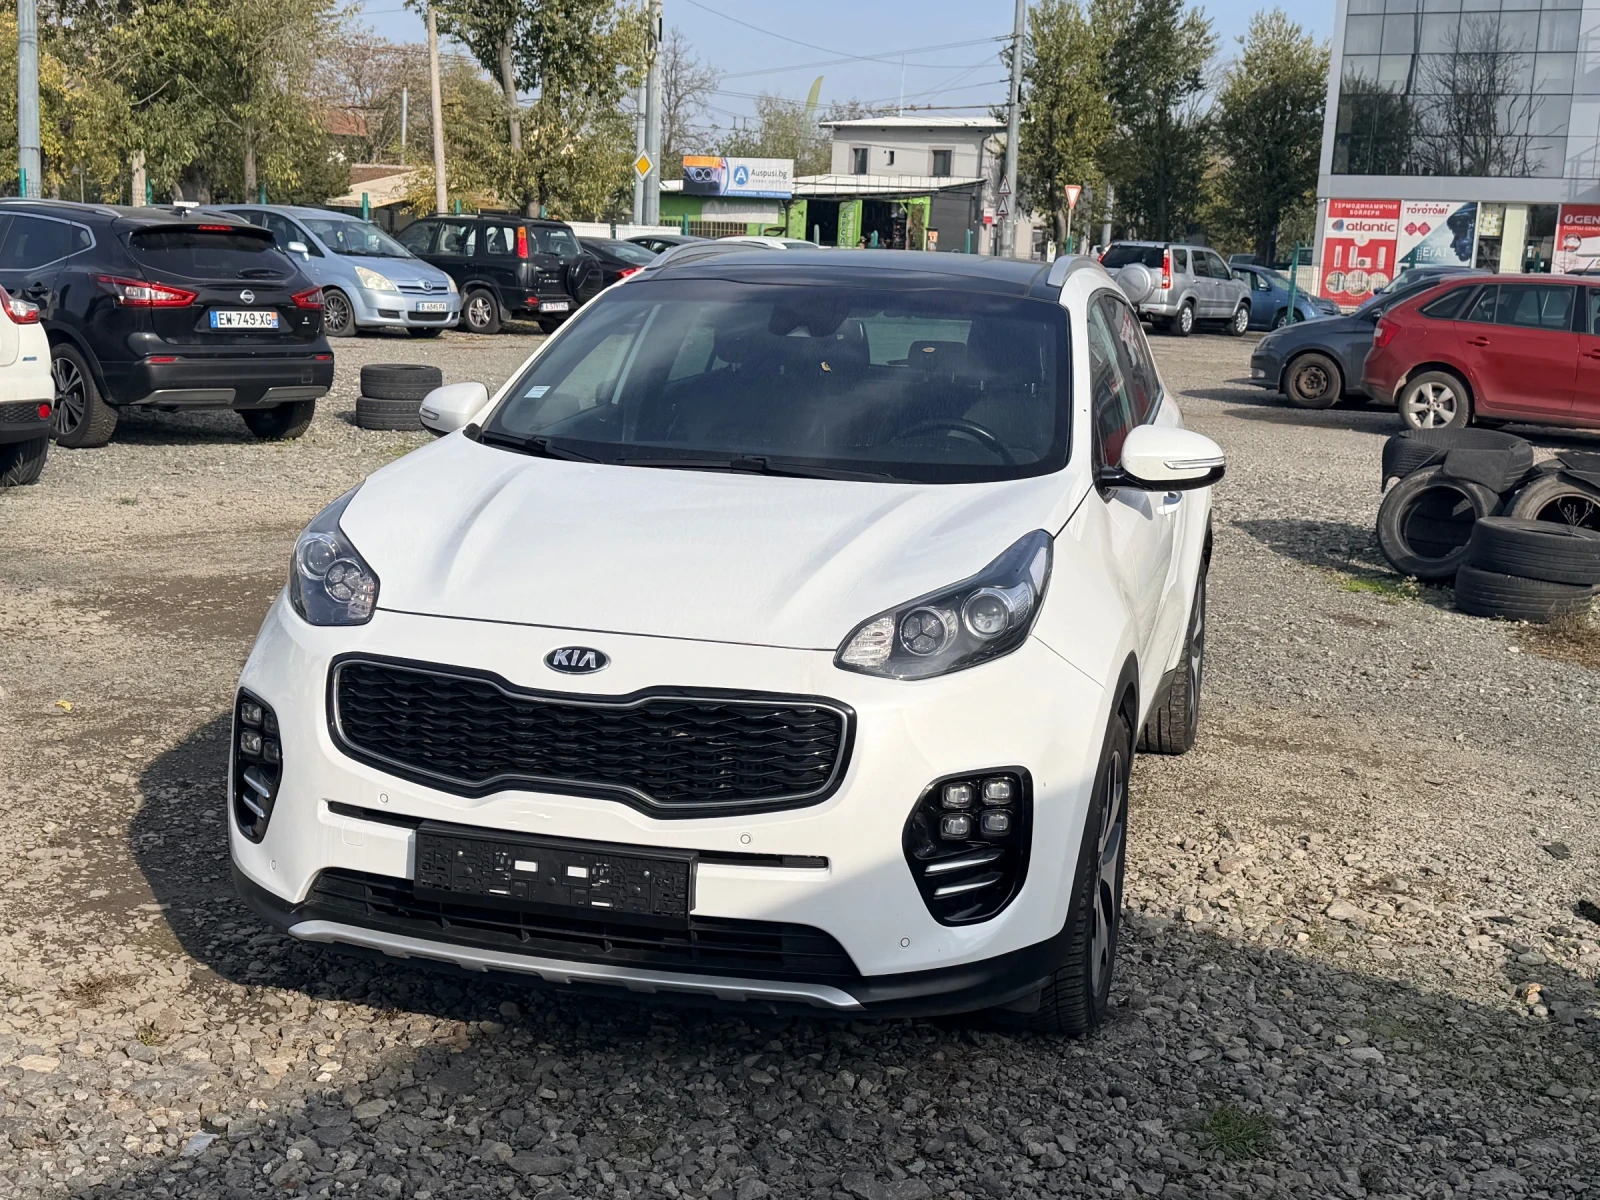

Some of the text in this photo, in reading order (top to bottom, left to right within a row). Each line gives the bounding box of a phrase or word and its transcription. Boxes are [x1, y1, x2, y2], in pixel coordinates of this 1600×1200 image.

[751, 168, 787, 179] Auspusi.bg
[1406, 205, 1448, 214] TOYOTOMI
[1346, 221, 1395, 232] atlantic
[218, 312, 272, 326] EW-749-XG
[552, 649, 597, 669] KIA
